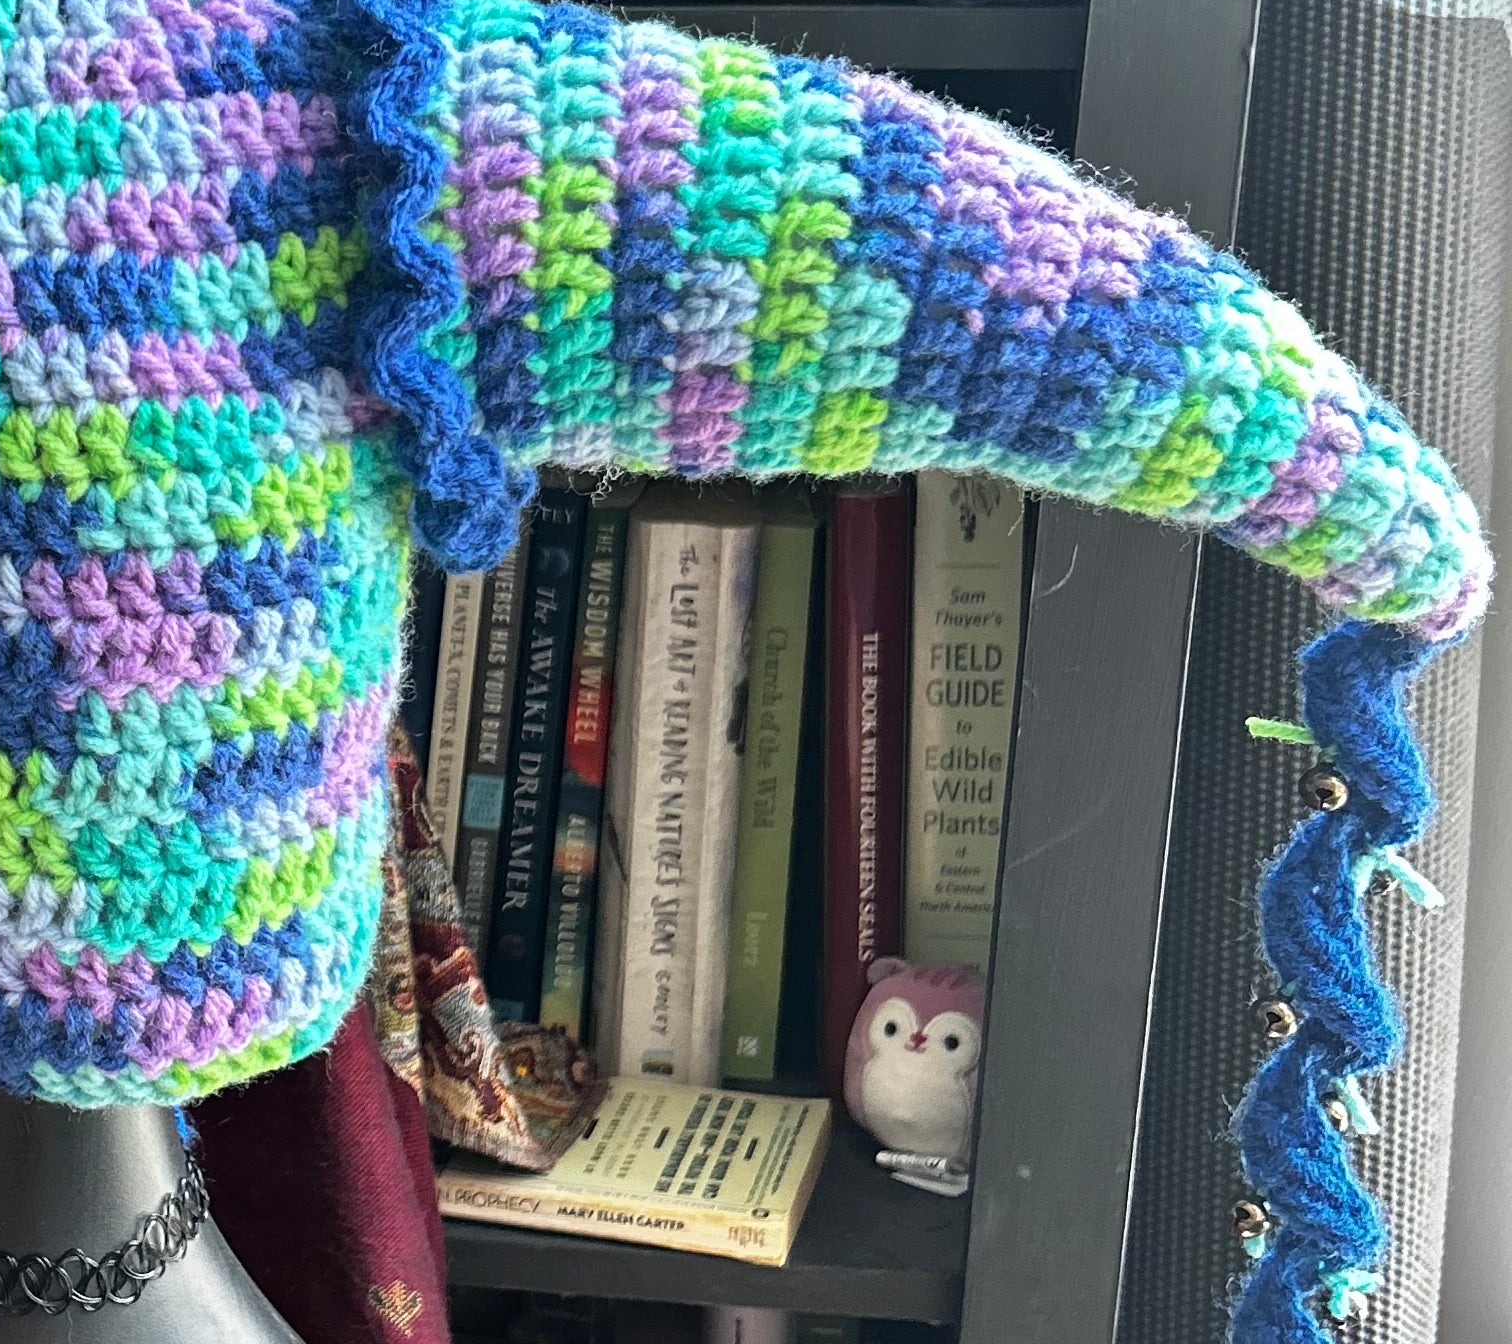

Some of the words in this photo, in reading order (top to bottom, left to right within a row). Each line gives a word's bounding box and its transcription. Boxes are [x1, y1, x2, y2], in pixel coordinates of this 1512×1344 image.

[595, 523, 615, 554] THE
[678, 544, 700, 577] The
[532, 585, 558, 622] The
[582, 559, 614, 659] WISDOM
[669, 583, 700, 630] LOST
[950, 586, 987, 605] Sam
[934, 608, 1004, 630] Thayer's
[487, 627, 510, 665] HAS
[667, 635, 698, 678] ART
[761, 626, 789, 705] Church
[860, 631, 879, 673] THE
[929, 643, 1003, 672] FIELD
[444, 667, 462, 734] COMETS
[482, 668, 506, 715] YOUR
[519, 631, 556, 742] AWAKE
[573, 665, 604, 745] WHEEL
[859, 676, 878, 736] BOOK
[926, 679, 1005, 708] GUIDE
[477, 718, 502, 765] BACK
[659, 699, 691, 785] READING
[758, 711, 782, 735] of
[955, 719, 973, 736] to
[757, 736, 781, 770] the
[858, 737, 878, 793] WITH
[924, 745, 1003, 772] Edible
[752, 777, 777, 830] Wild
[932, 778, 993, 804] Wild
[500, 748, 545, 914] DREAMER
[923, 809, 1000, 836] Plants
[858, 795, 877, 899] FOURTEEN
[649, 894, 680, 959] SIGNS
[856, 901, 876, 962] SEALS
[453, 1188, 541, 1213] PROPHECY
[556, 1206, 594, 1220] MARY
[596, 1210, 634, 1226] ELLEN
[635, 1216, 685, 1231] CARTER
